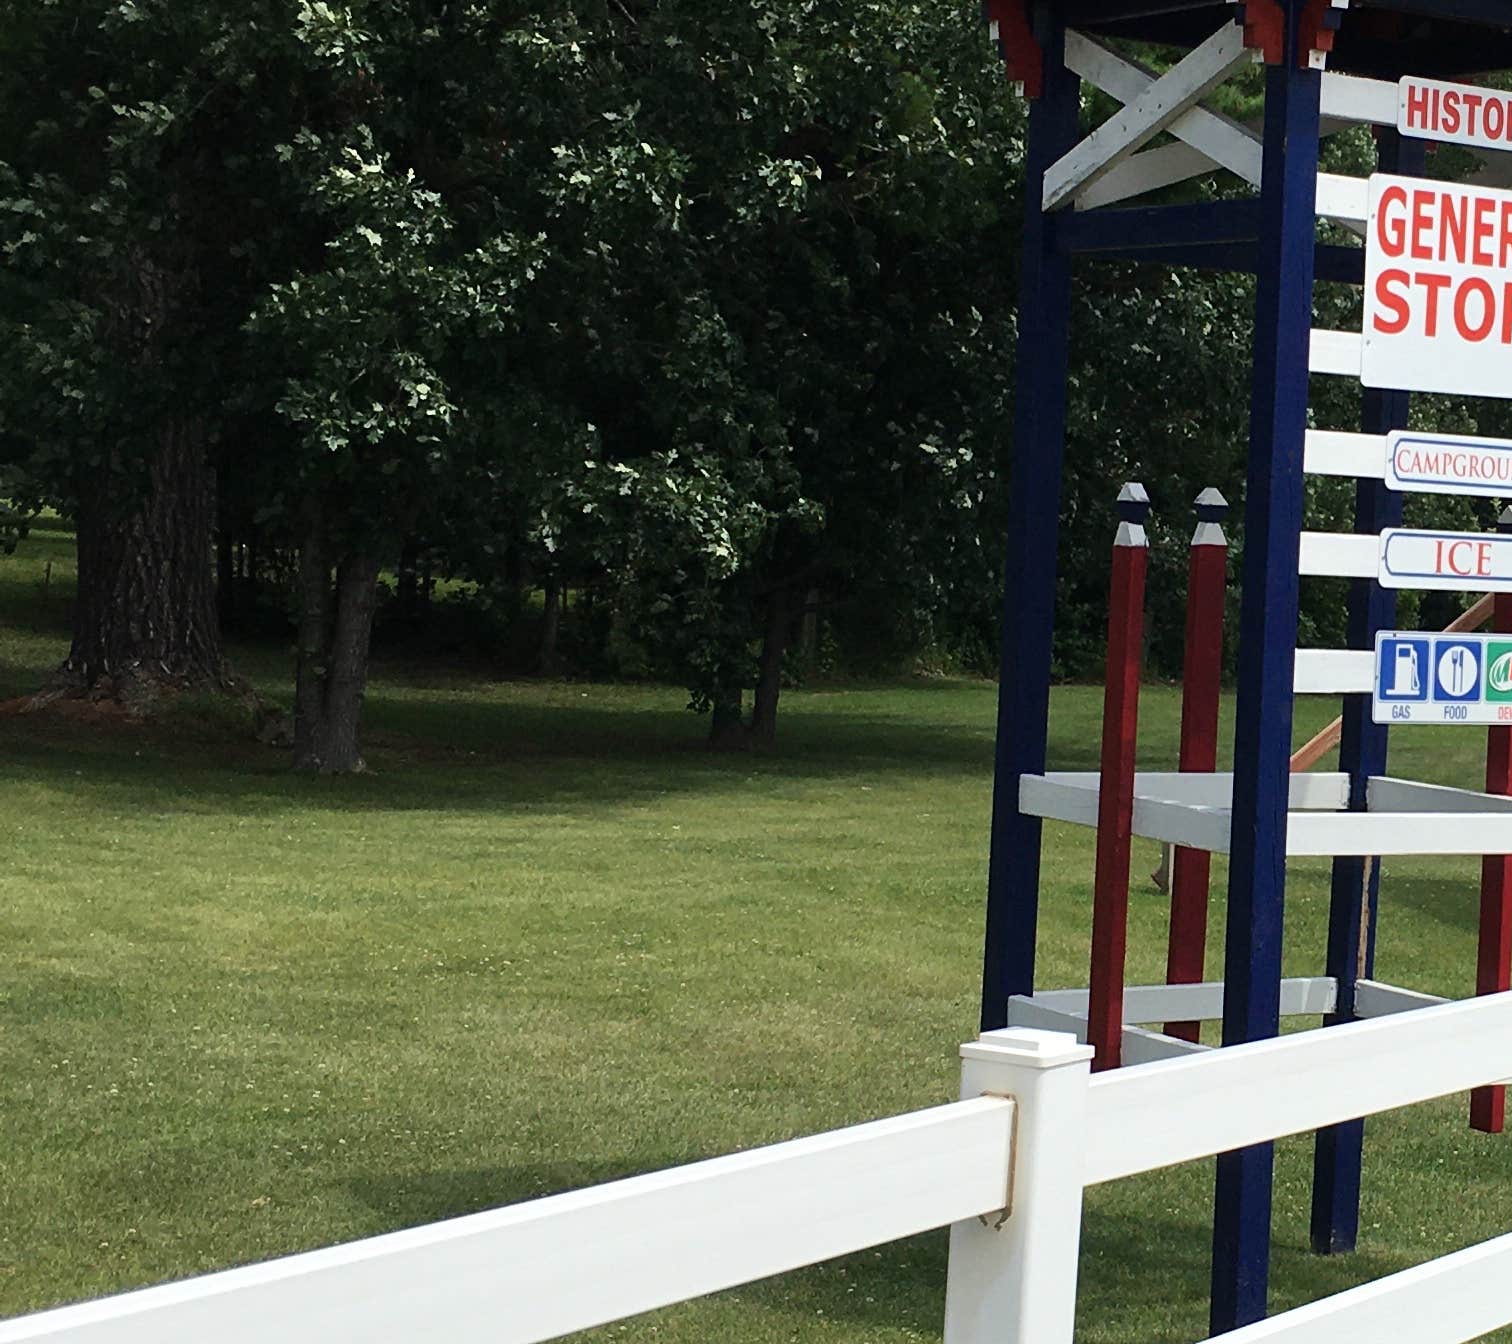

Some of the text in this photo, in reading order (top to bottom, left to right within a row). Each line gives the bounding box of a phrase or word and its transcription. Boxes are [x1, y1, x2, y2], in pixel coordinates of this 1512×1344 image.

[1434, 540, 1493, 576] ICE
[1392, 705, 1411, 720] GAS
[1444, 705, 1468, 720] FOOD
